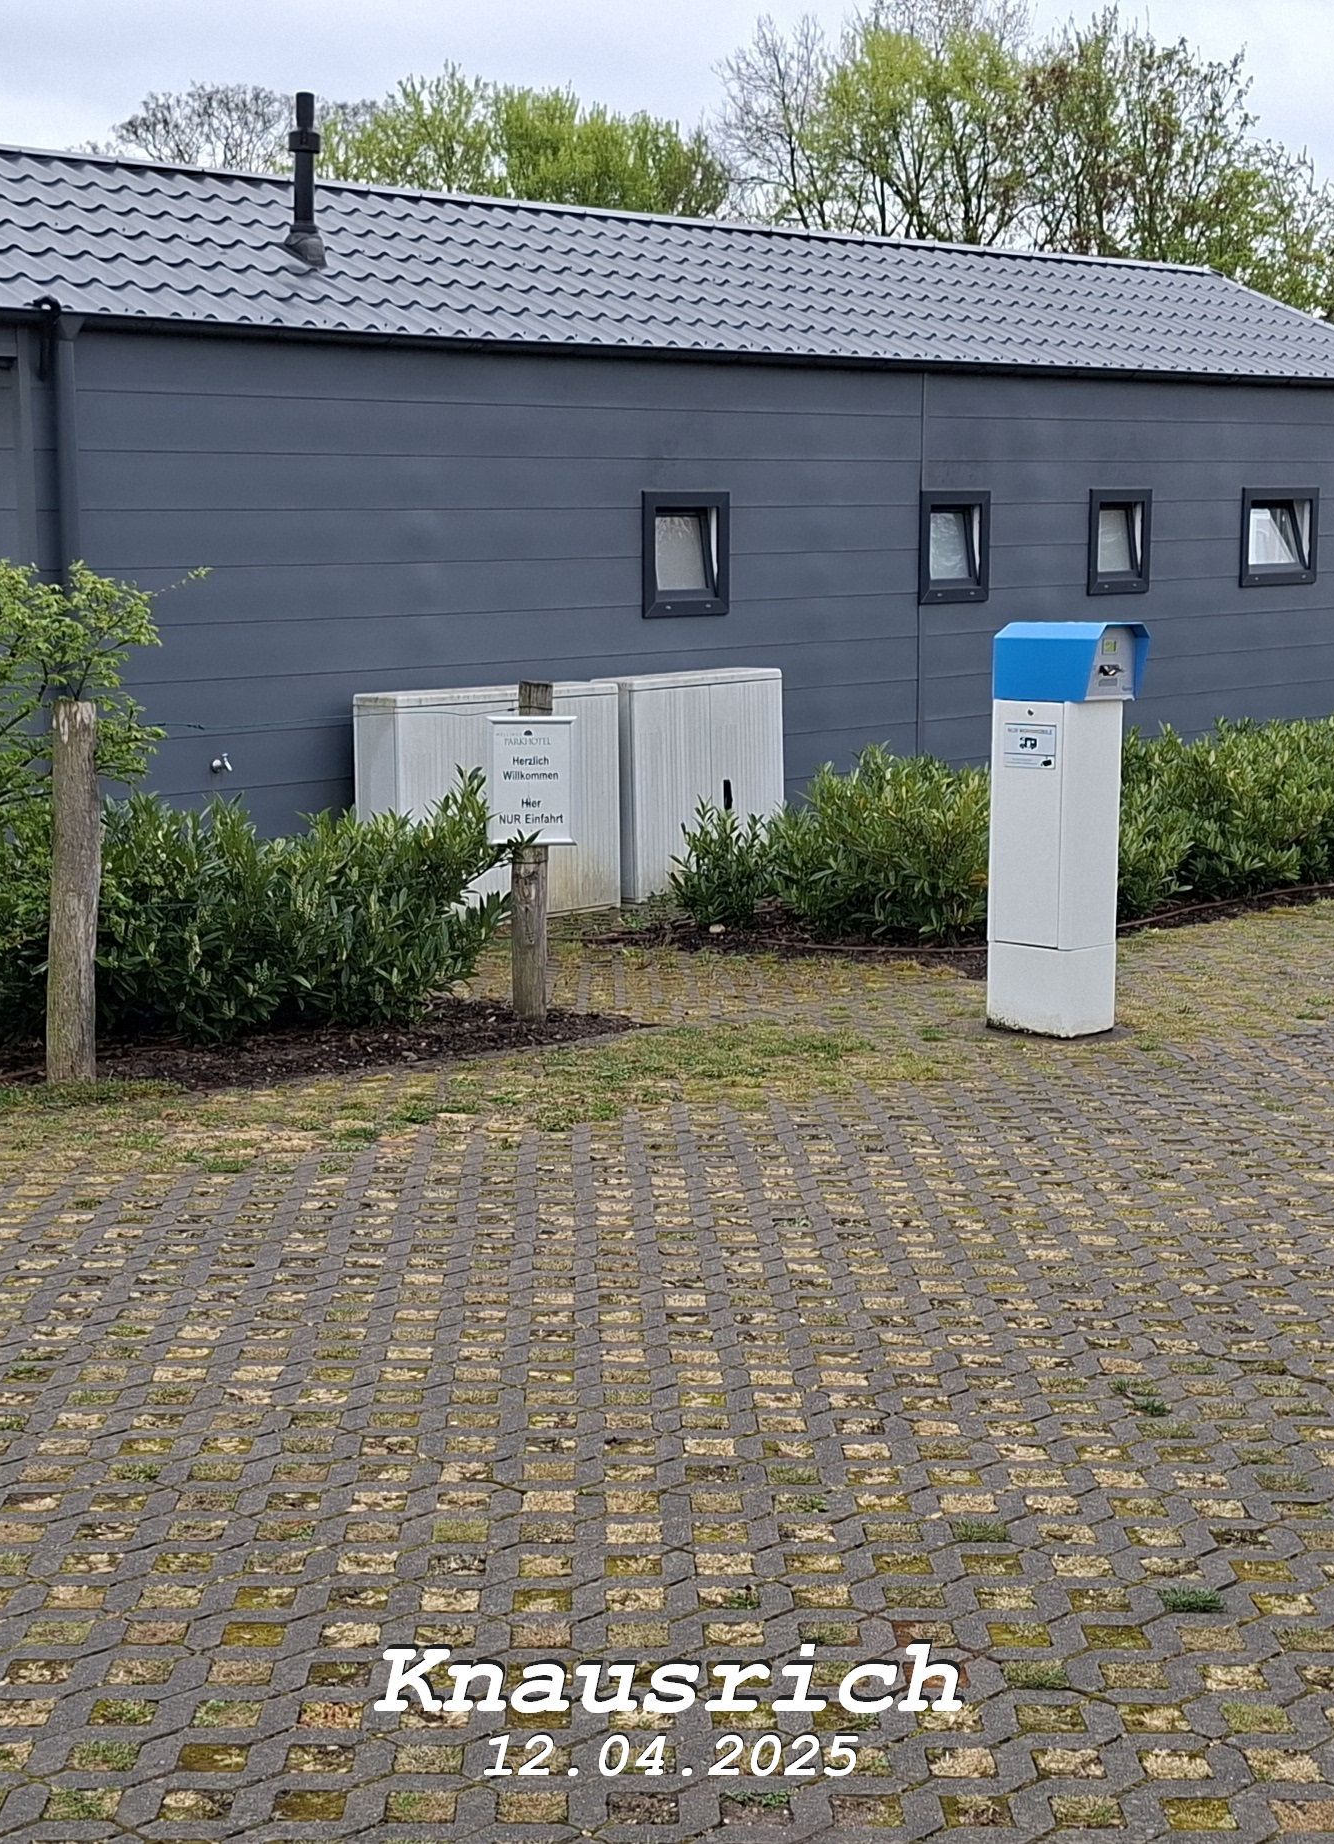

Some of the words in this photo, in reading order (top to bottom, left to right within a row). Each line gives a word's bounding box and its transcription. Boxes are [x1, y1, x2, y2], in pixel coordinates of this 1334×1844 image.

[512, 755, 550, 766] Herzlich
[503, 770, 559, 781] Willkommen
[521, 797, 542, 808] Hier
[499, 814, 522, 825] NUR
[525, 813, 564, 824] Einfahrt
